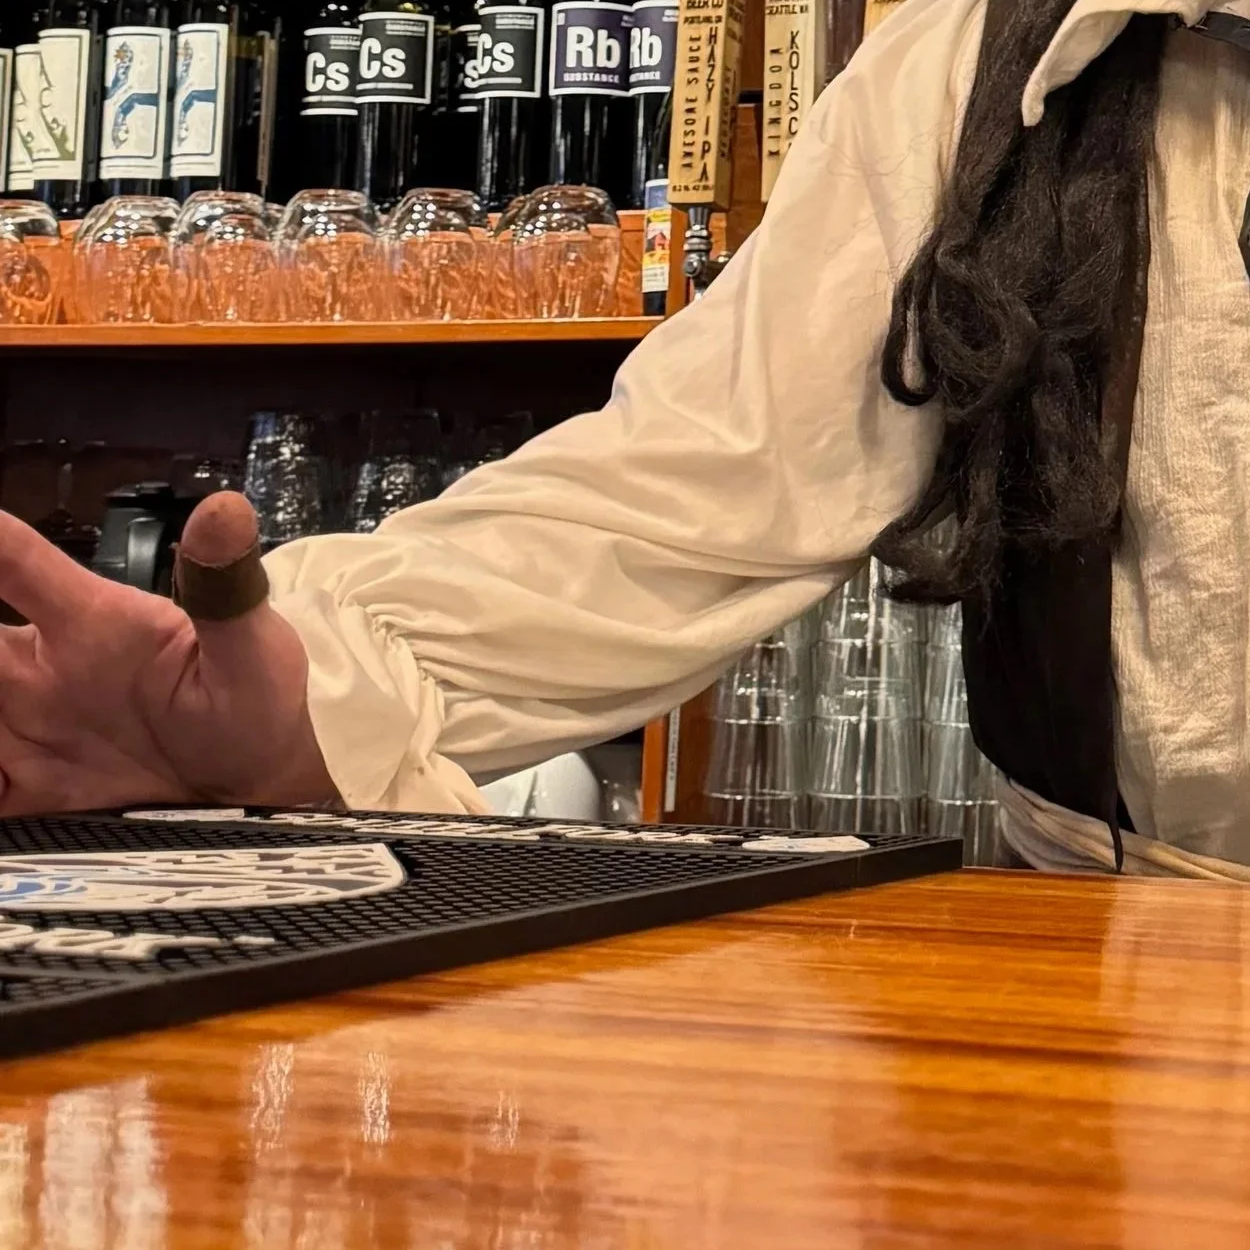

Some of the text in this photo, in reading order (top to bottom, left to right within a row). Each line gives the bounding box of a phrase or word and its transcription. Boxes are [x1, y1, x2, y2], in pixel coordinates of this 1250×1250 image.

[360, 37, 406, 79] Cs
[476, 33, 515, 74] Cs
[566, 26, 621, 69] Rb
[630, 26, 663, 70] Rb
[306, 52, 349, 92] Cs
[563, 72, 620, 84] SUBSTANCE
[788, 30, 800, 150] KOLSC
[682, 34, 702, 169] AWESOME SAUCE
[700, 26, 719, 183] HAZY IPA
